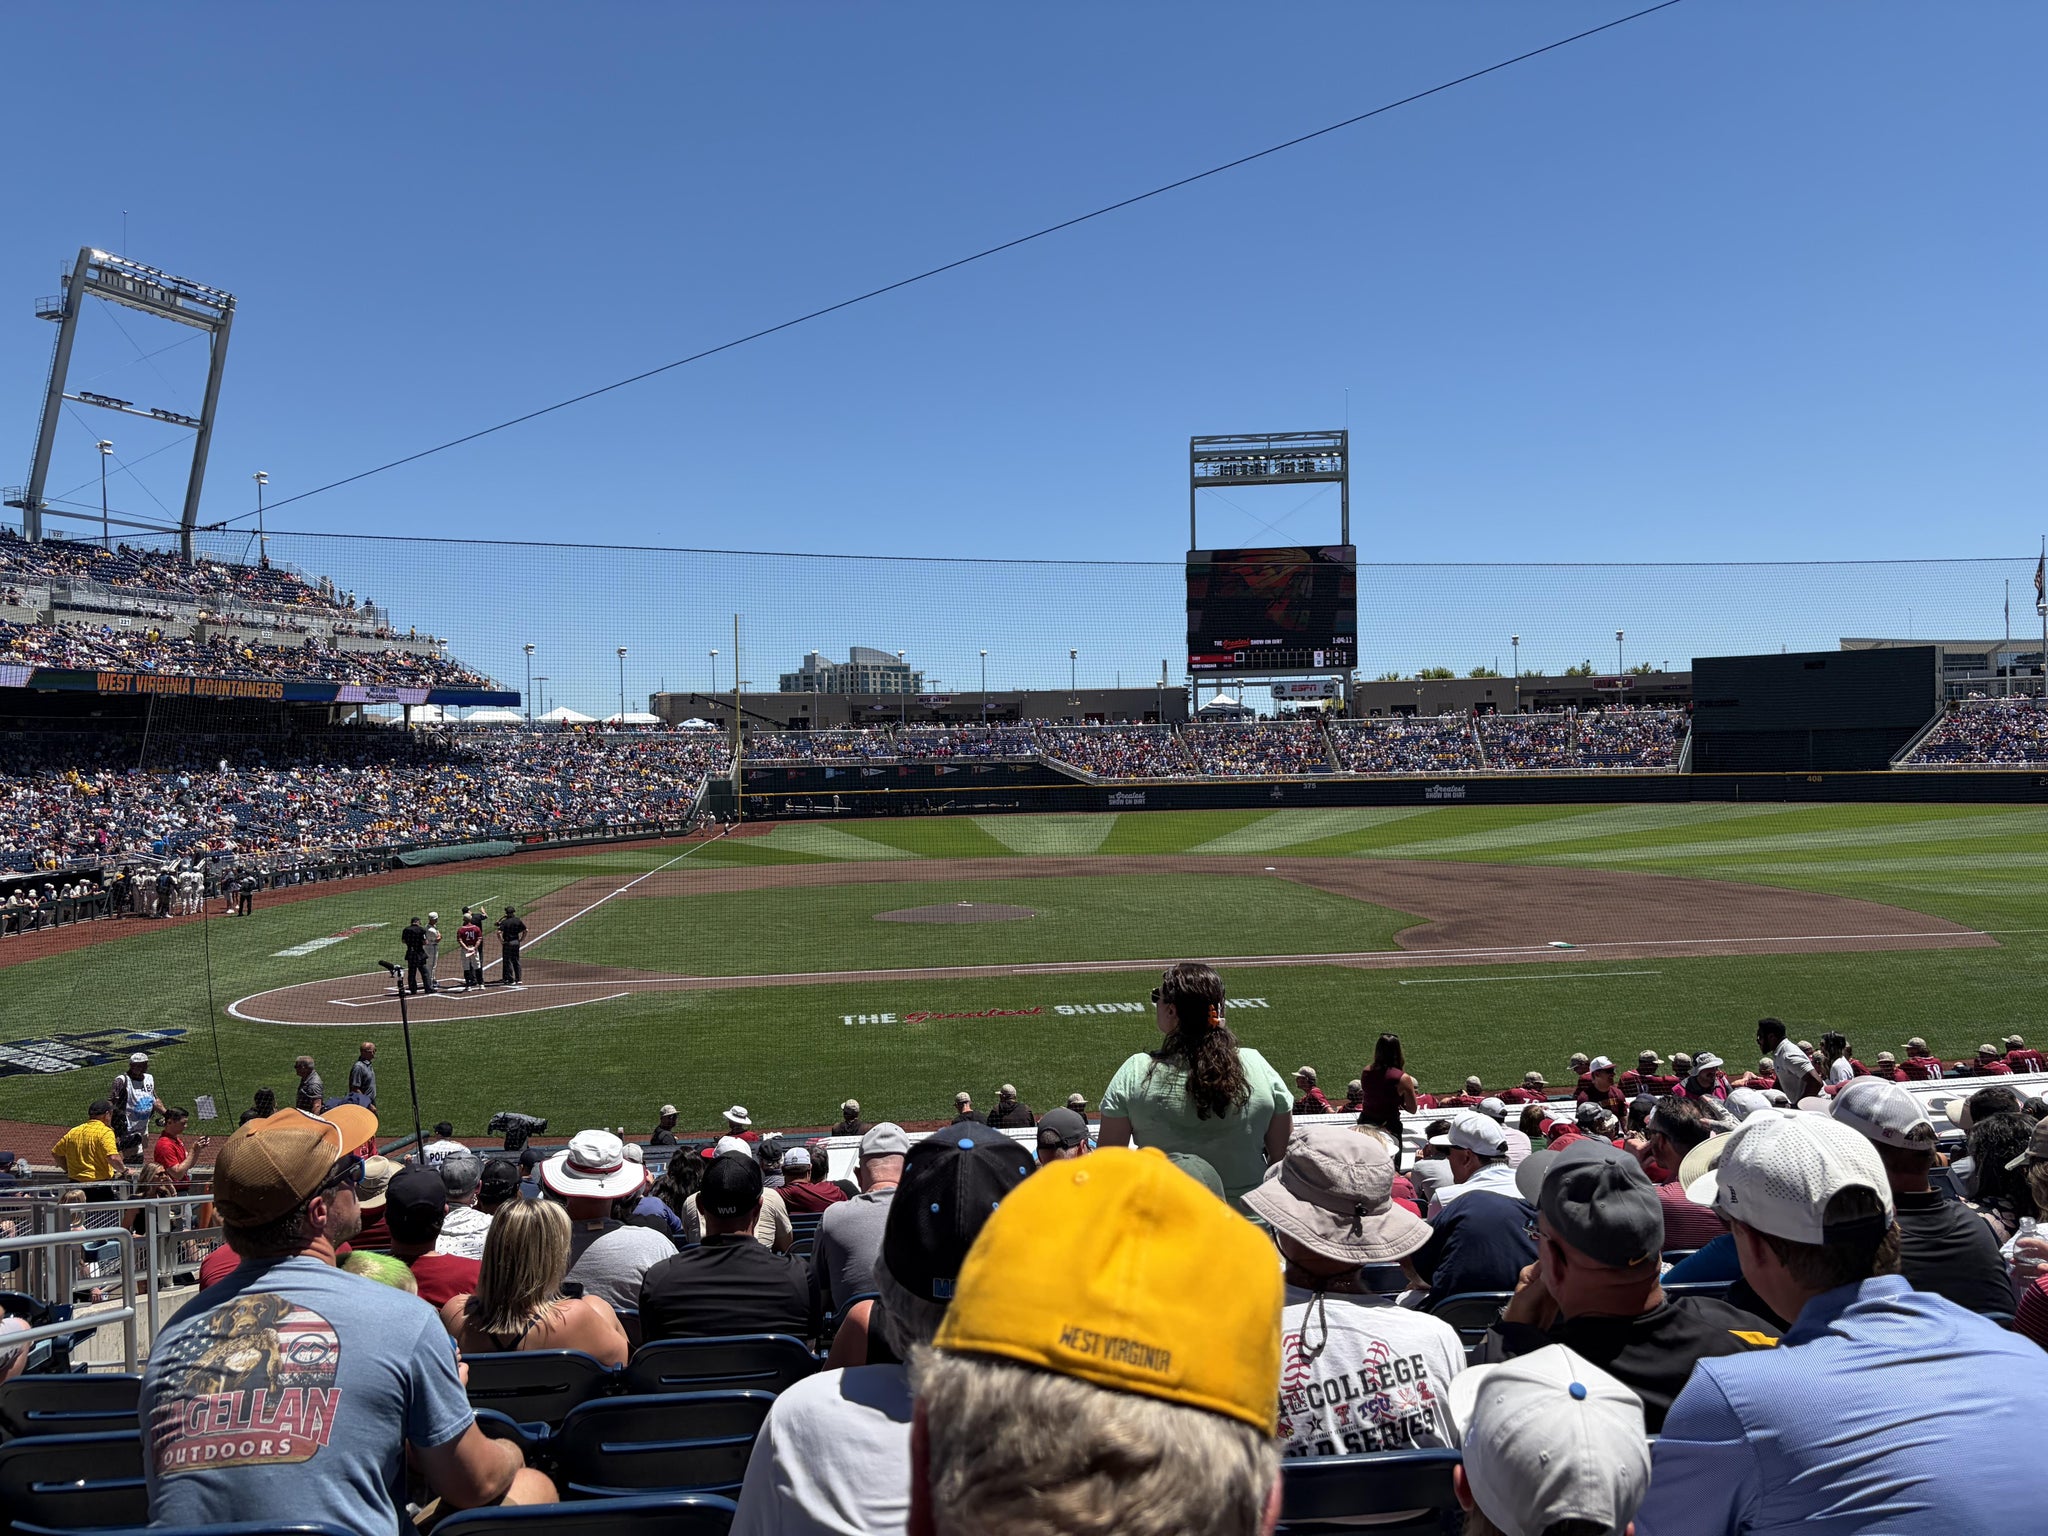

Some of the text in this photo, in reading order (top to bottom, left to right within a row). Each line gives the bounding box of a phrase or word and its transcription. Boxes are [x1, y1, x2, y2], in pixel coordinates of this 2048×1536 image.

[96, 672, 284, 699] WEST VIRGINIA MOUNTAINEERS
[1291, 684, 1317, 692] ESPN
[1303, 782, 1317, 790] 375
[1807, 775, 1823, 783] 408
[1115, 791, 1146, 800] Greatest
[1433, 784, 1466, 793] Greatest
[465, 930, 475, 941] 24
[839, 998, 1271, 1025] THE Greatest SHOW IRT
[717, 1206, 737, 1215] WVU
[1059, 1323, 1172, 1374] WEST VIRGINIA
[1306, 1353, 1427, 1410] COLLEGE
[1358, 1397, 1391, 1420] TCU
[1344, 1408, 1436, 1455] SERIES
[163, 1437, 291, 1466] OUTDOORS
